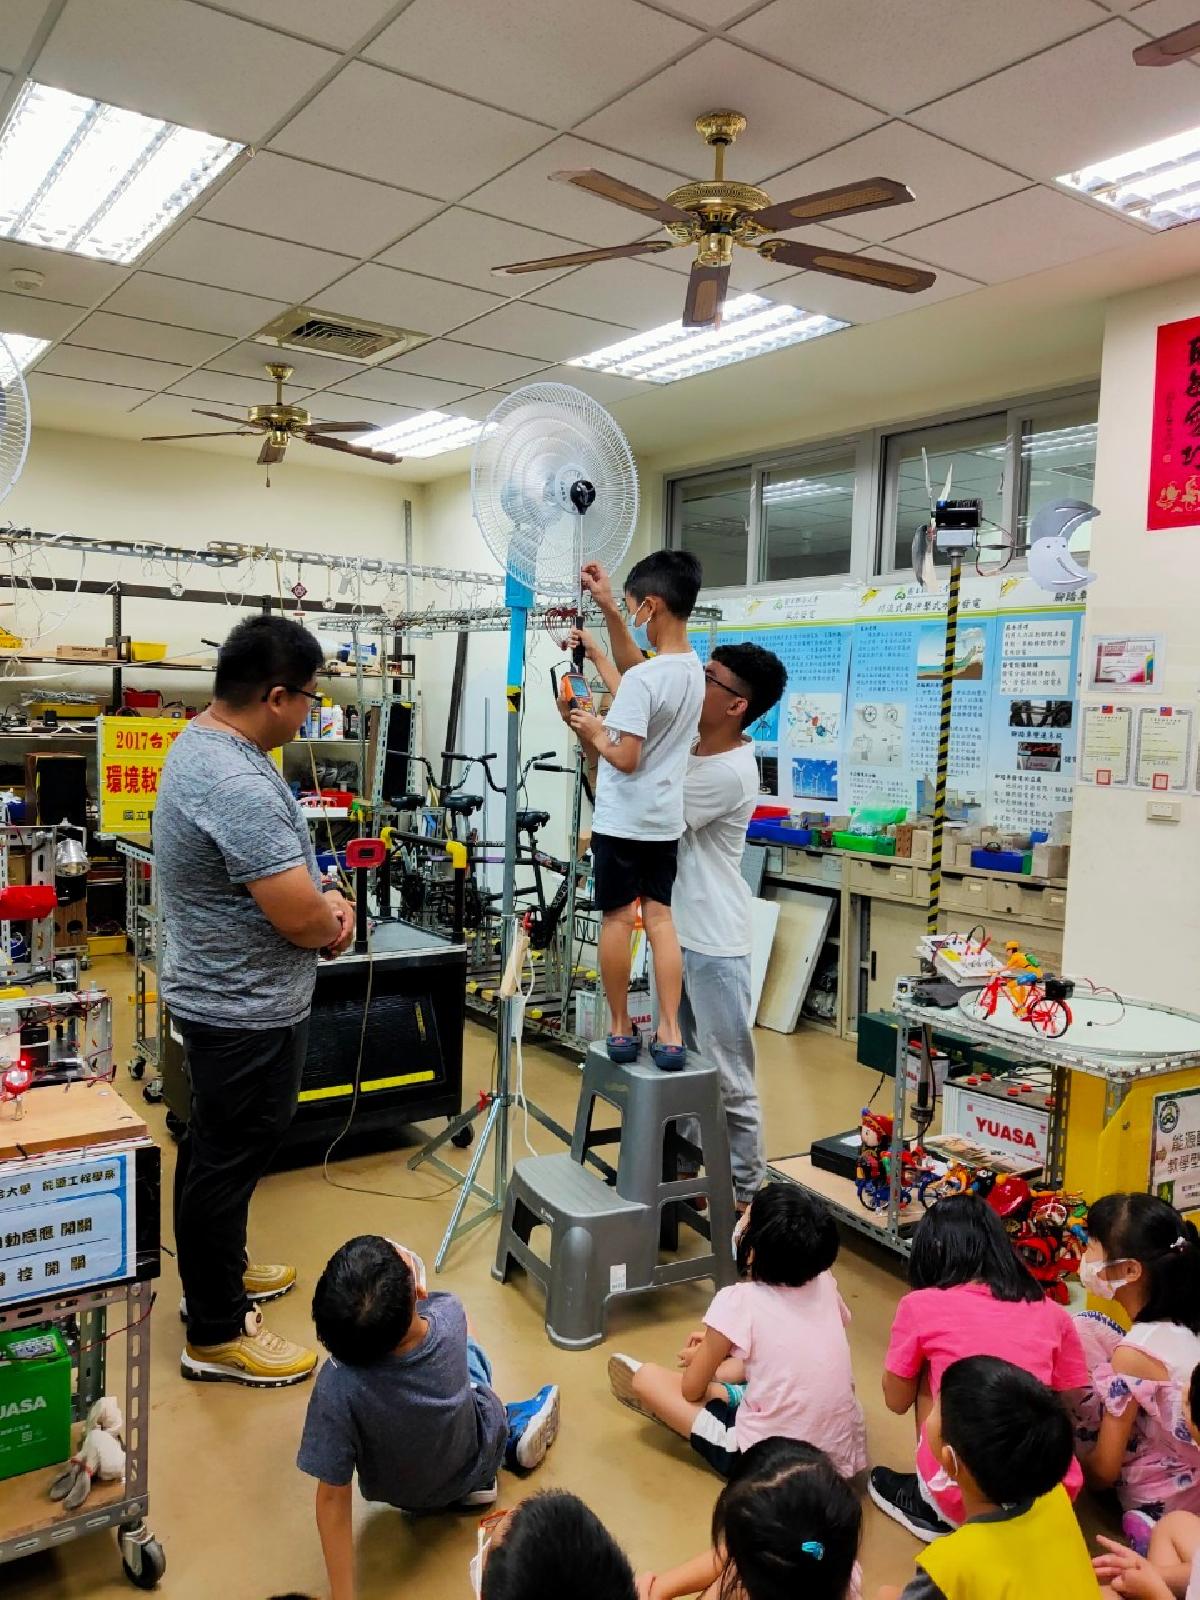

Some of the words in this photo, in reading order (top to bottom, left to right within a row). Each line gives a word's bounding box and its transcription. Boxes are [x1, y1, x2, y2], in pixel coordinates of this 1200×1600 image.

[106, 765, 163, 794] 環境教
[976, 1116, 1037, 1149] YUASA
[42, 1169, 116, 1192] 能源工程學系
[0, 1225, 54, 1249] 動感應
[61, 1217, 92, 1237] 開關
